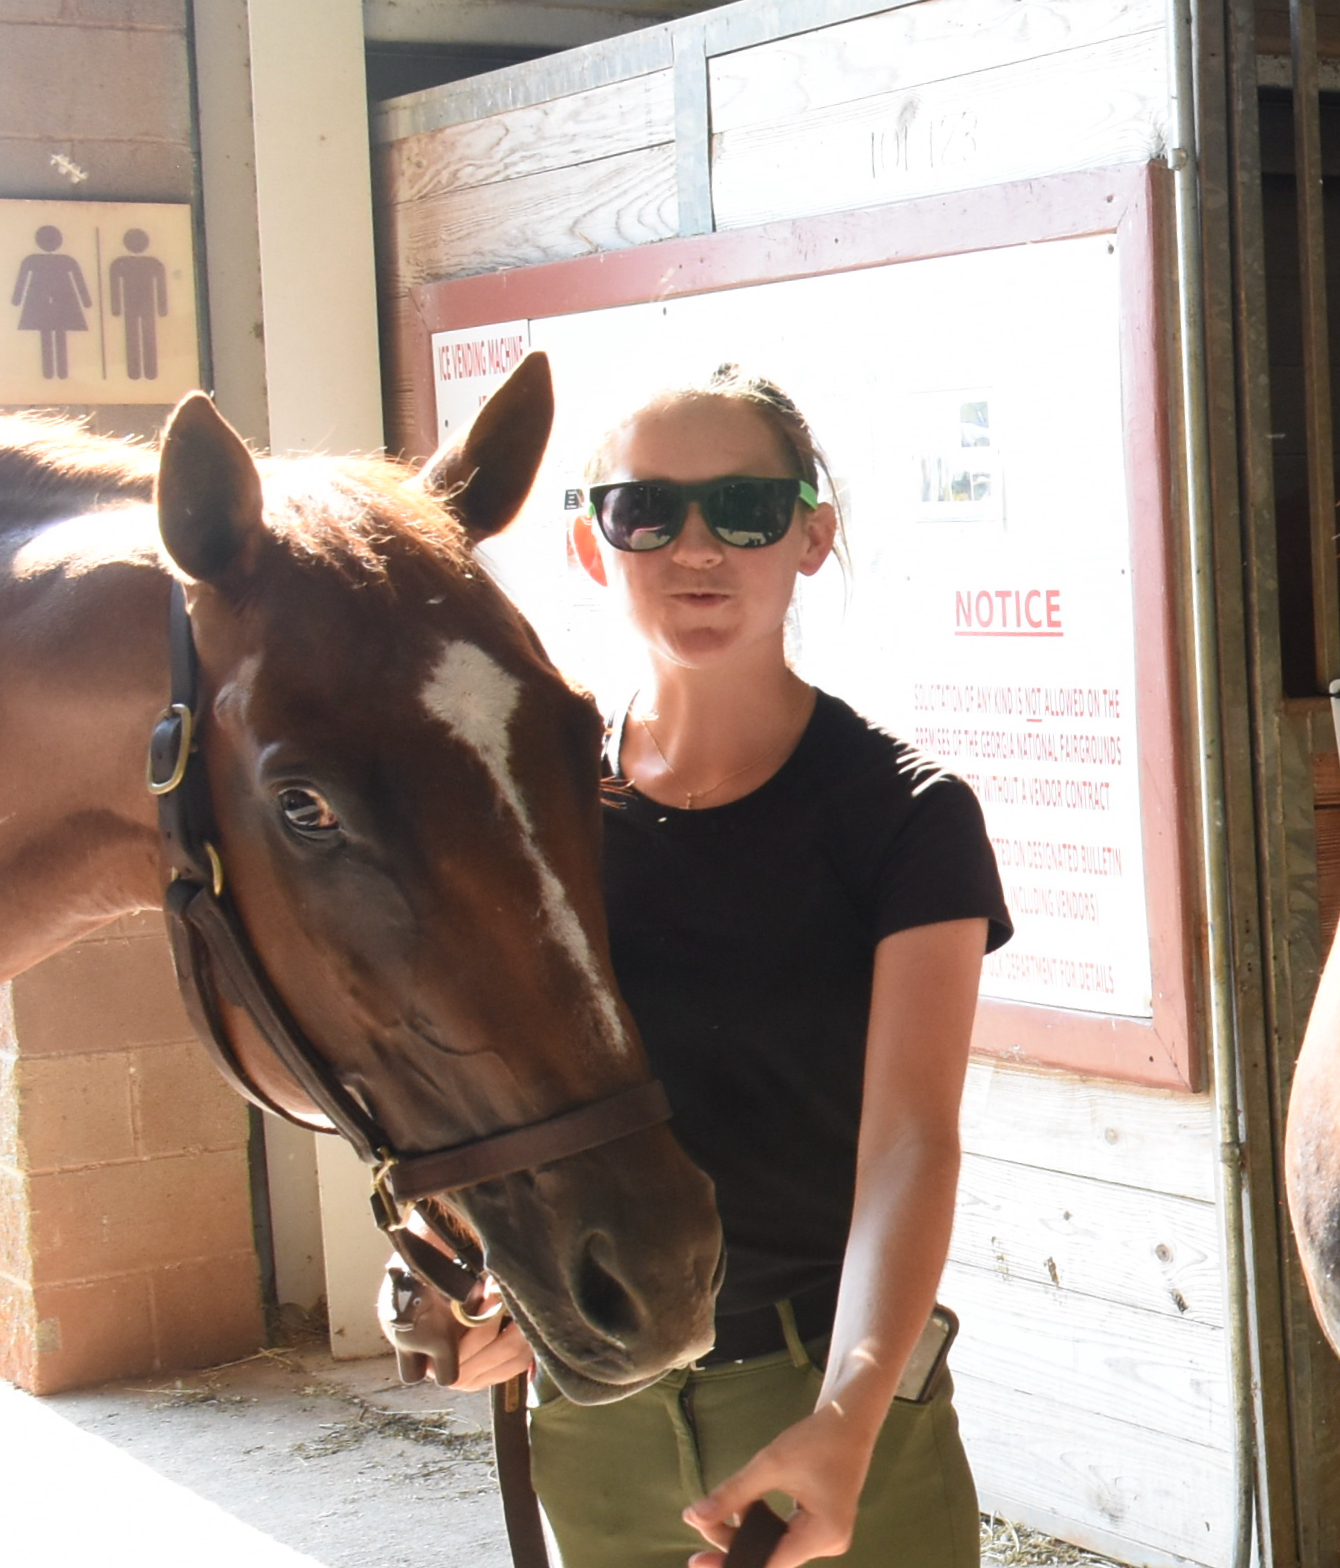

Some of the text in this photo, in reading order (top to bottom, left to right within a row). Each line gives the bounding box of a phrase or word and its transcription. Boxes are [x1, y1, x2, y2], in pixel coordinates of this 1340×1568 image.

[438, 345, 451, 381] ICE
[451, 340, 486, 380] VENDING
[955, 589, 1062, 628] NOTICE
[914, 683, 1120, 719] SOLICITATION OF ANY KIND IS NOT ALLOWED ON THE
[915, 727, 1122, 765] PREMISES OF THE GEORGIA NATIONAL FAIRGROUNDS
[983, 775, 1019, 805] WITHOUT
[1022, 777, 1028, 805] A
[1029, 777, 1063, 808] VENDOR
[1065, 779, 1110, 811] CONTRACT
[1013, 839, 1026, 868] ON
[1027, 840, 1079, 873] DESIGNATED
[1081, 844, 1123, 877] BULLETIN
[1005, 952, 1058, 987] DEPARTMENT
[1060, 959, 1078, 989] FOR
[1078, 961, 1115, 994] DETAILS
